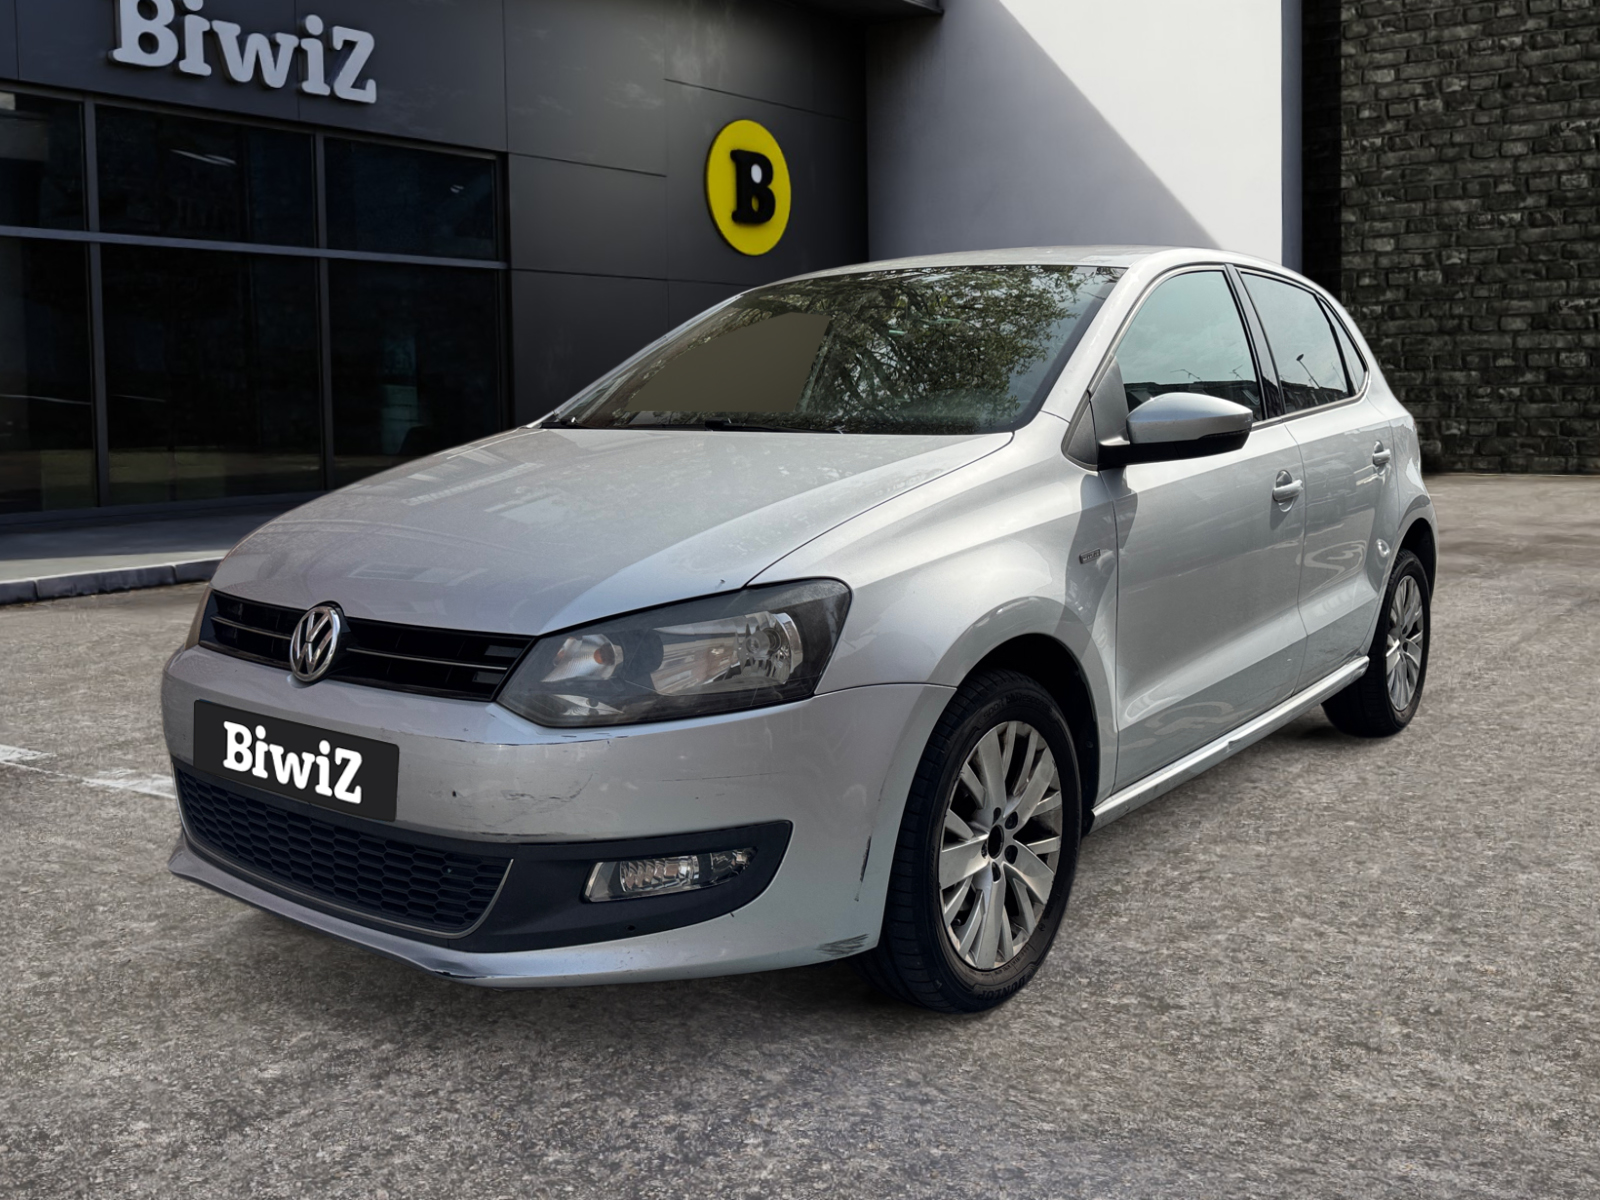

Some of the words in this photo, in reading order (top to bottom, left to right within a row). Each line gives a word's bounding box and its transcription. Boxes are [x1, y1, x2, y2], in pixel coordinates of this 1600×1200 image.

[112, 0, 377, 104] BiwiZ
[730, 149, 776, 225] B
[223, 721, 362, 804] BiwiZ
